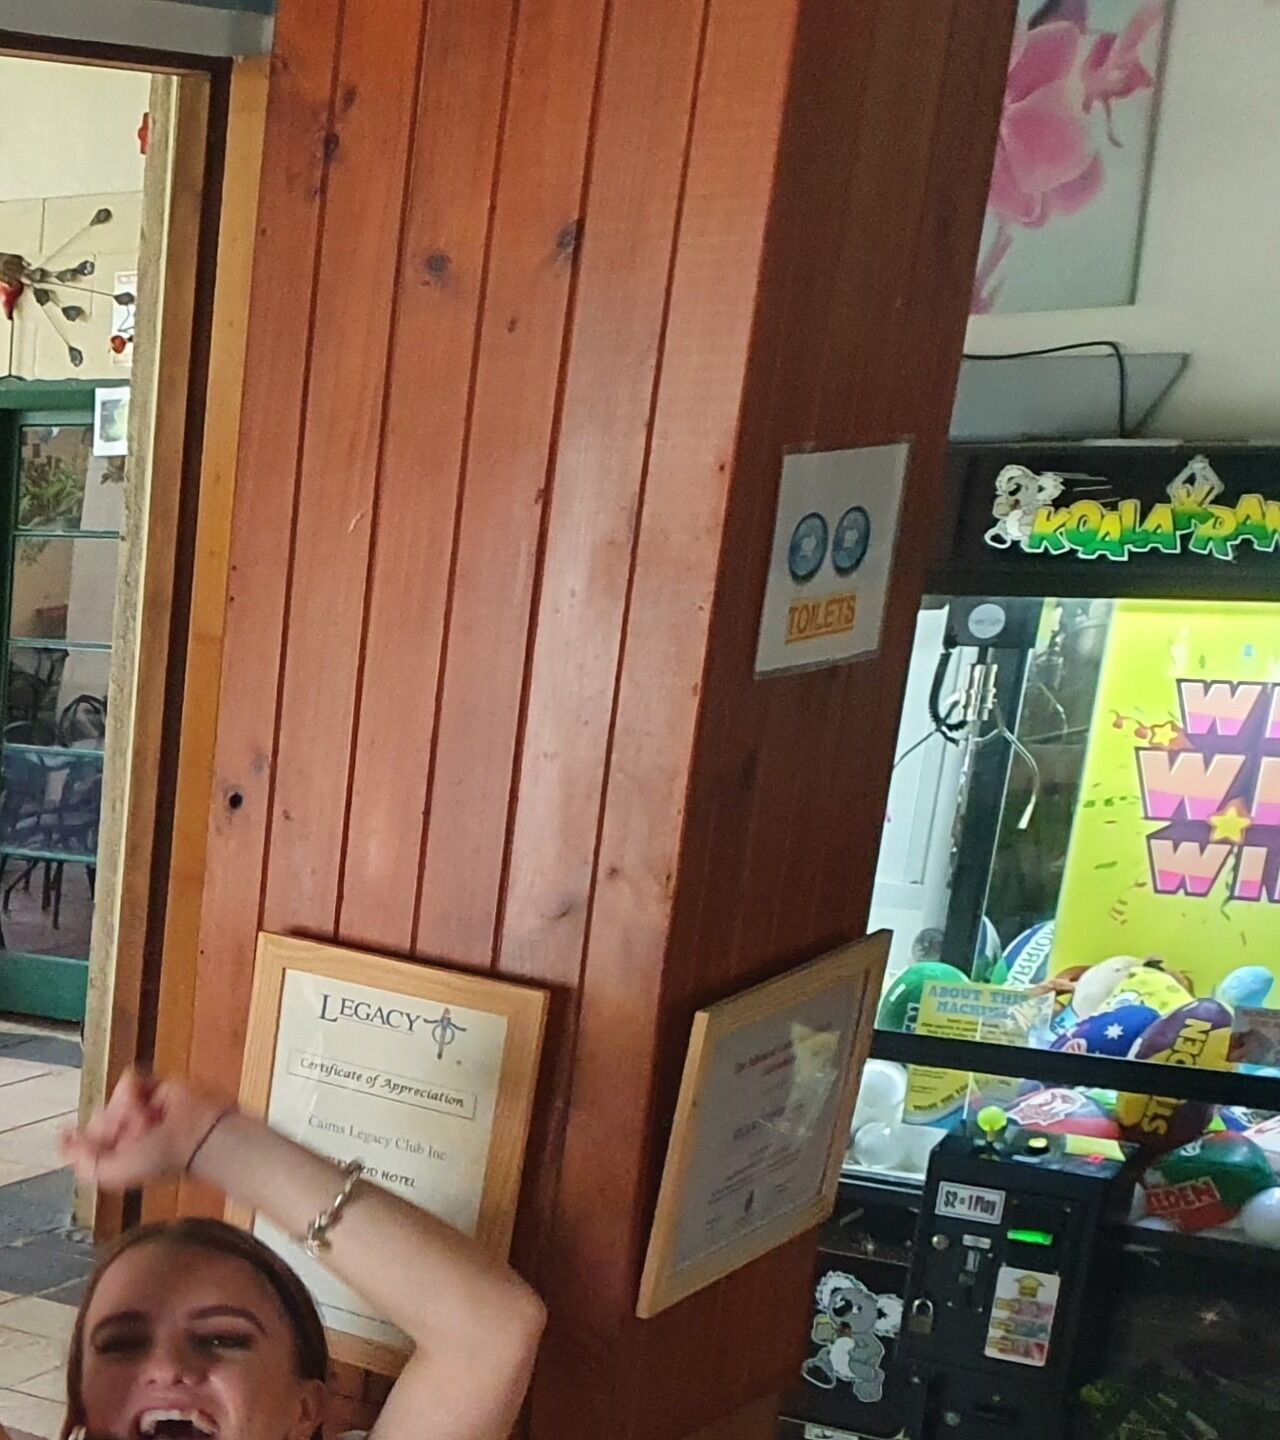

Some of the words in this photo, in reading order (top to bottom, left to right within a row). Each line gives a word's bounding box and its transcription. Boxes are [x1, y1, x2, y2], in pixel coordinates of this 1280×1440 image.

[1022, 498, 1181, 561] KOALA
[788, 595, 857, 636] TOILETS
[318, 993, 421, 1032] LEGACY
[928, 984, 982, 1002] ABOUT
[300, 1056, 363, 1083] Certificate
[365, 1073, 380, 1089] of
[380, 1078, 464, 1109] Appreciation
[349, 1123, 394, 1150] Legacy
[394, 1134, 426, 1157] Club
[427, 1144, 448, 1162] Inc
[380, 1169, 417, 1190] HOTEL
[943, 1189, 958, 1210] $2
[973, 1194, 997, 1217] Play
